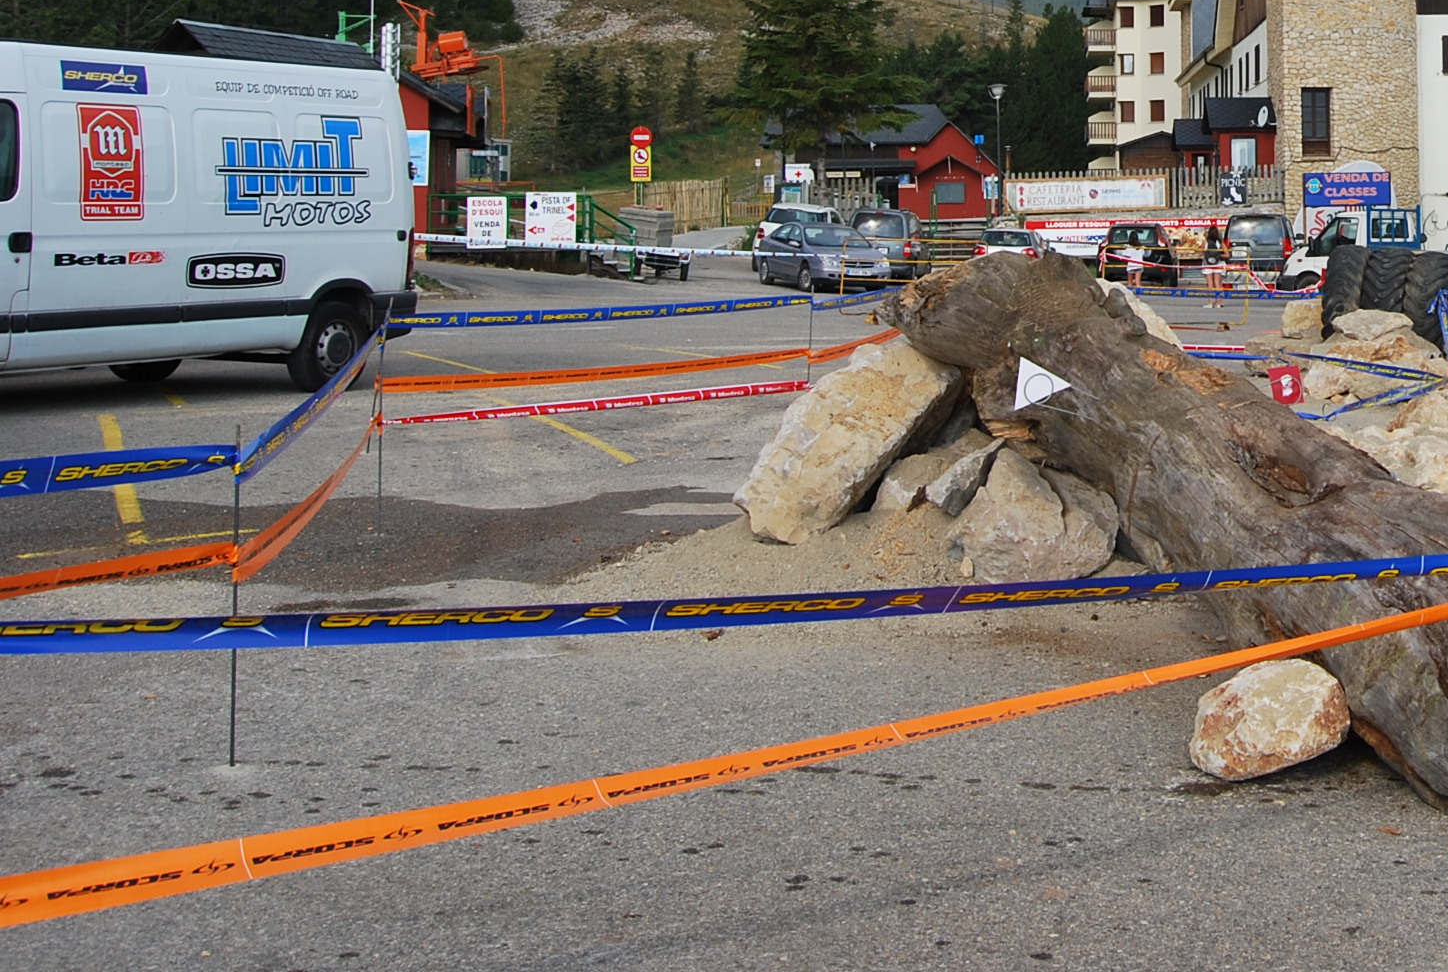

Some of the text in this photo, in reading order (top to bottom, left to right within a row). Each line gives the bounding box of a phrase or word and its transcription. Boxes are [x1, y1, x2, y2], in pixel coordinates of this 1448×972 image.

[64, 70, 138, 84] SHERCO
[214, 81, 359, 100] EQUIP DE COMPETICIÓ OFF ROAD
[222, 114, 362, 216] LIMIT
[1221, 178, 1246, 187] PICNIC
[1324, 172, 1390, 183] VENDA DE
[90, 178, 134, 200] HRC
[1028, 184, 1082, 195] CAFETERIA
[1324, 186, 1378, 197] CLASSES
[542, 196, 560, 204] PISTA
[1026, 196, 1086, 206] RESTAURANT
[85, 206, 138, 214] TRIAL TEAM
[264, 200, 372, 228] MOTOS
[474, 220, 500, 228] VENDA
[54, 252, 126, 266] Beta
[194, 262, 276, 280] OSSA
[54, 458, 188, 482] SHERCO
[318, 607, 556, 629] SHERCO
[664, 596, 868, 618] SHERCO
[958, 586, 1132, 605] SHERCO
